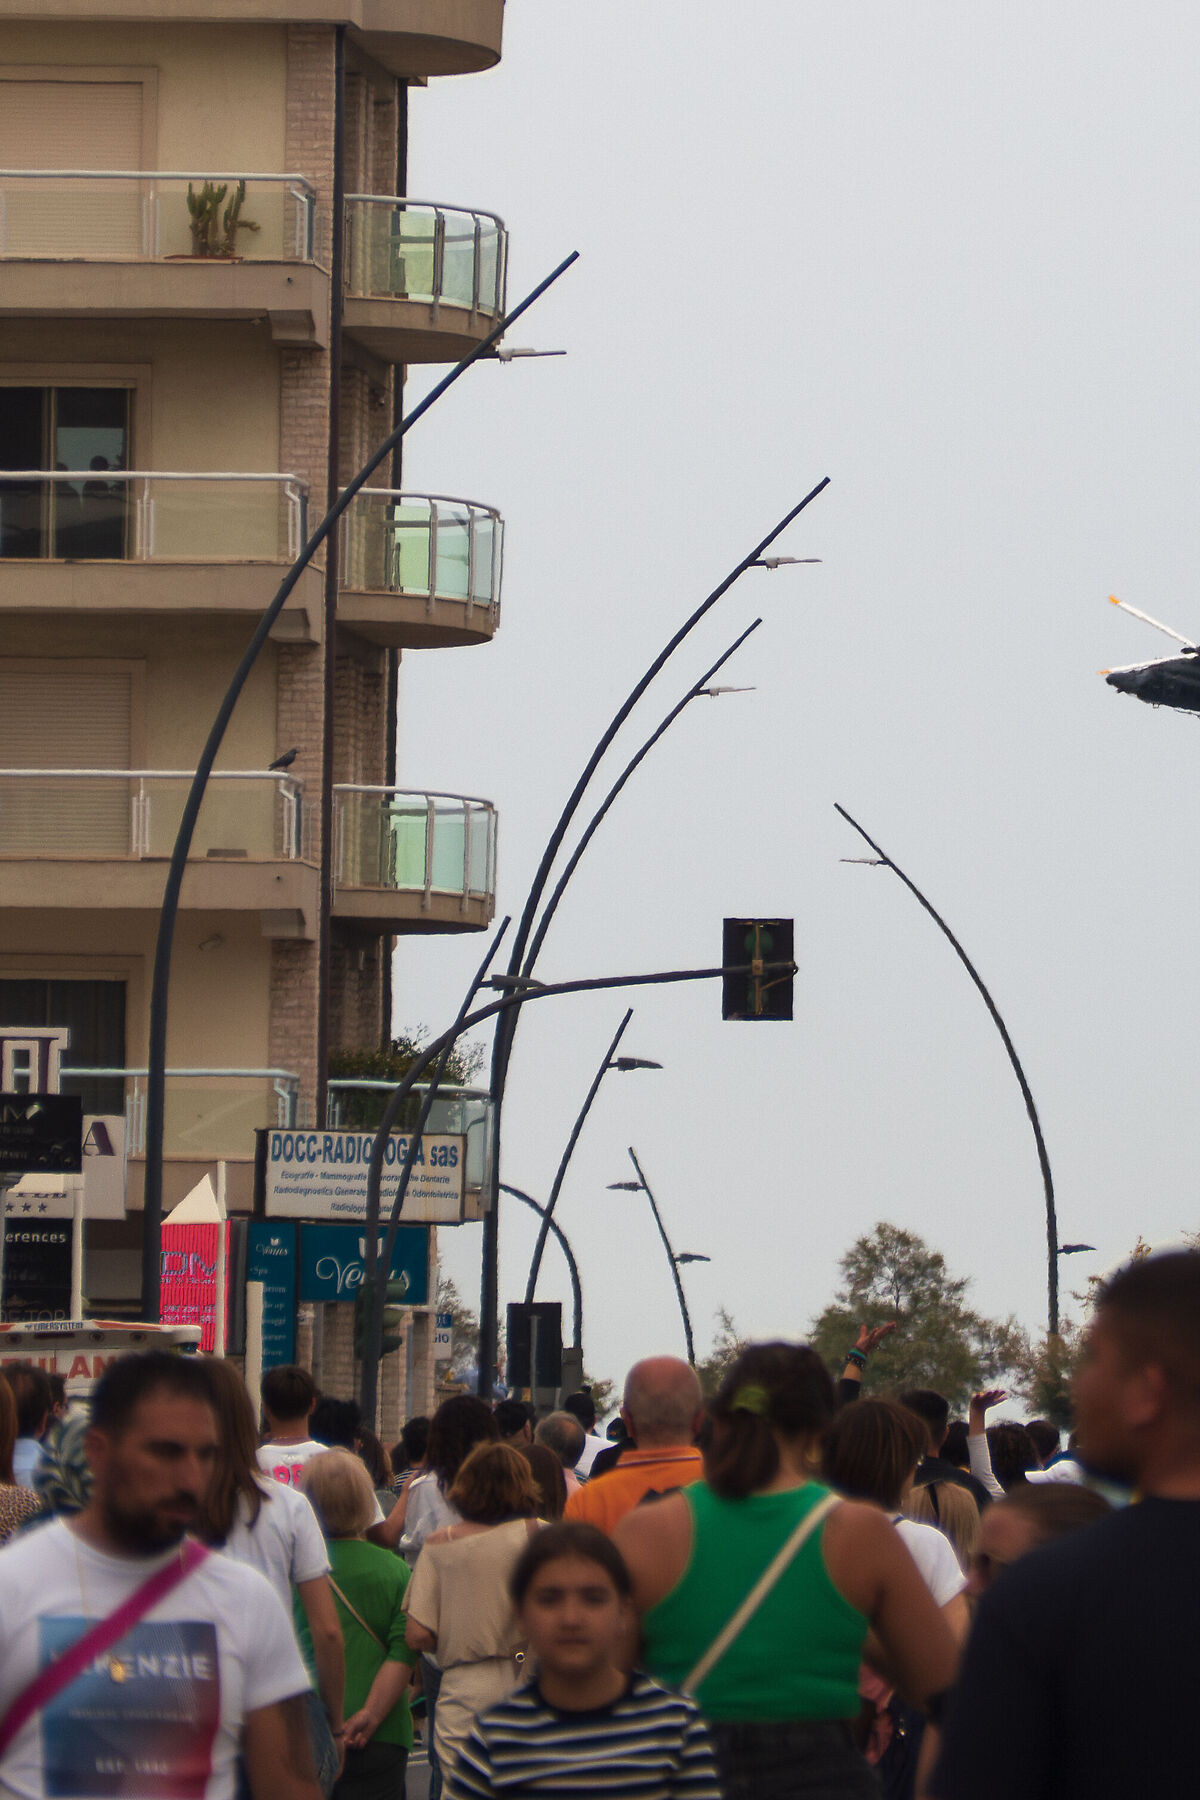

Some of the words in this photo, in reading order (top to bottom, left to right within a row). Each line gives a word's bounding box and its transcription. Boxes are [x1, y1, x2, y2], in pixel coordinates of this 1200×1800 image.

[271, 1133, 425, 1167] DOCC-RADIOOGA
[430, 1145, 459, 1168] sas
[5, 1231, 66, 1243] erences
